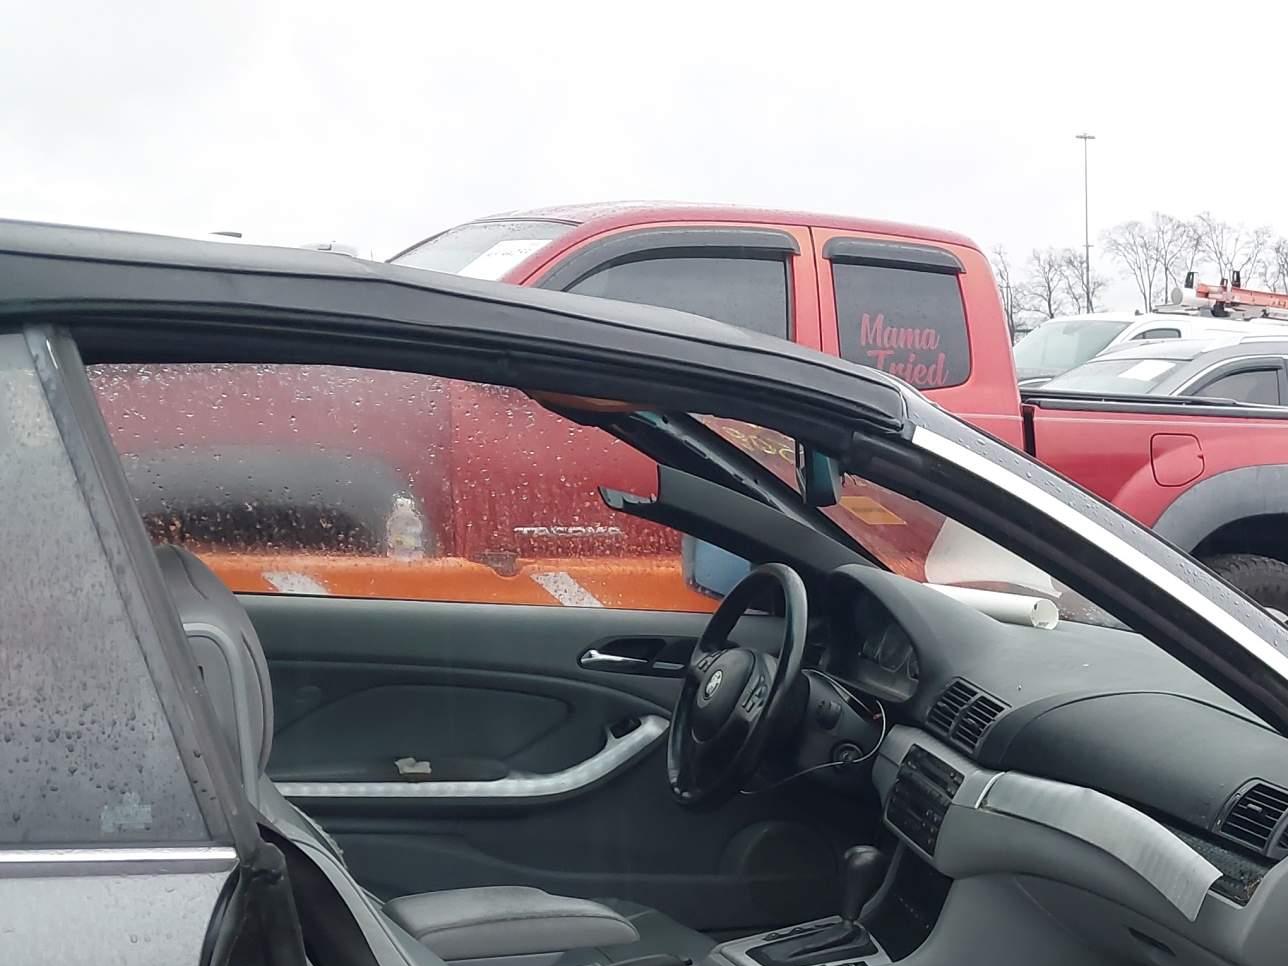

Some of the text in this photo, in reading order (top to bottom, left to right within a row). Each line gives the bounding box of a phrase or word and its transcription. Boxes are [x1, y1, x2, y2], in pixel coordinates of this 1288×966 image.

[860, 312, 940, 350] Mama
[866, 349, 950, 385] Tried
[513, 525, 624, 537] TACOMA
